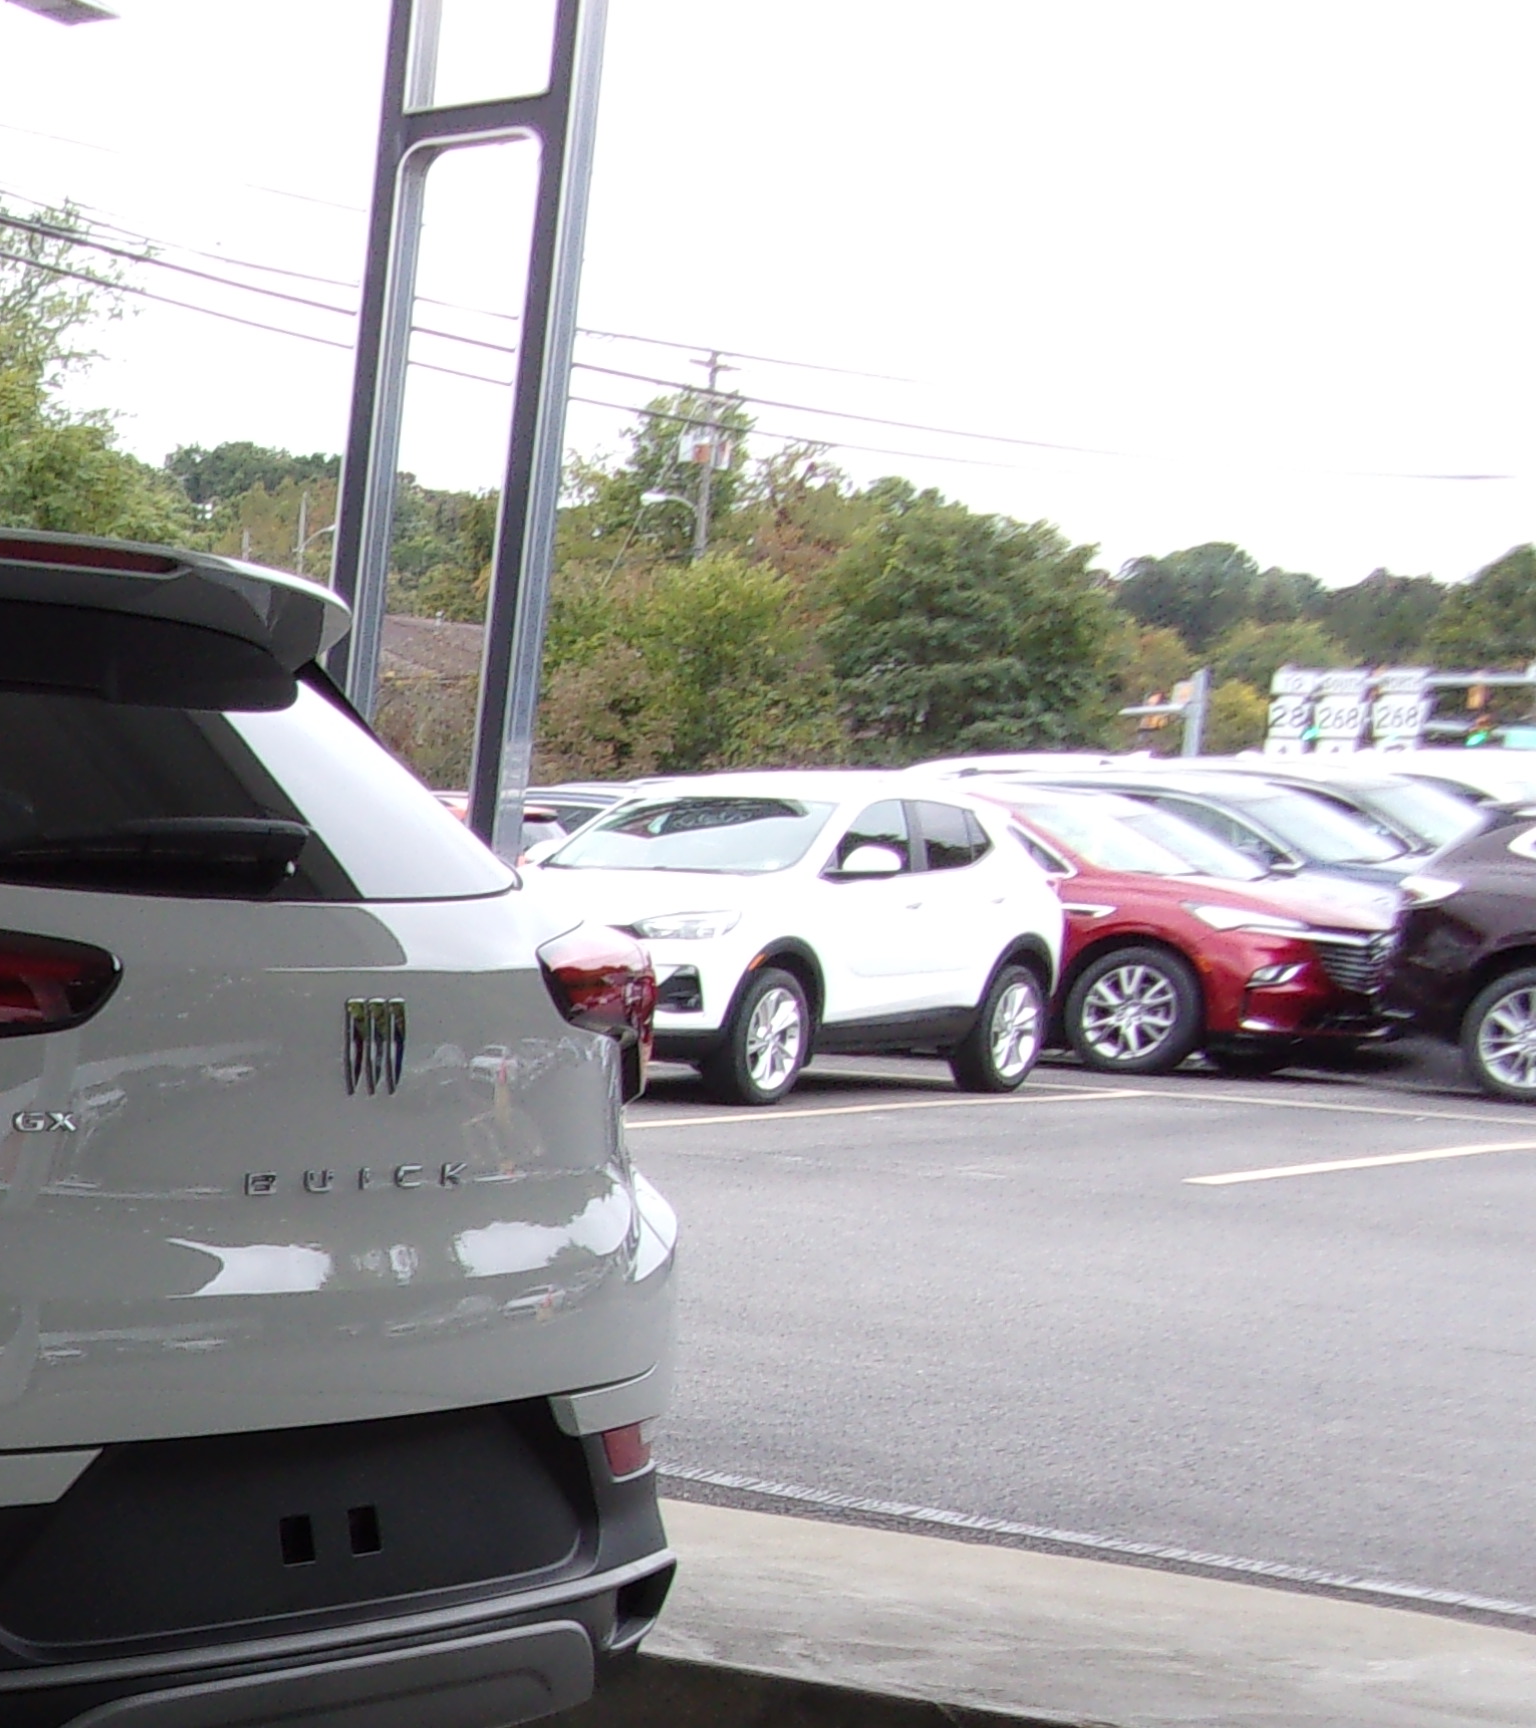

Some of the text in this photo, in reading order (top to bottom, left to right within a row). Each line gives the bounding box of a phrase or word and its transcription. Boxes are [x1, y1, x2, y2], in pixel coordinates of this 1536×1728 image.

[1271, 704, 1309, 729] 28
[1318, 706, 1360, 730] 268
[1376, 705, 1418, 729] 268
[12, 1110, 77, 1133] GX
[244, 1161, 468, 1197] BUICK
